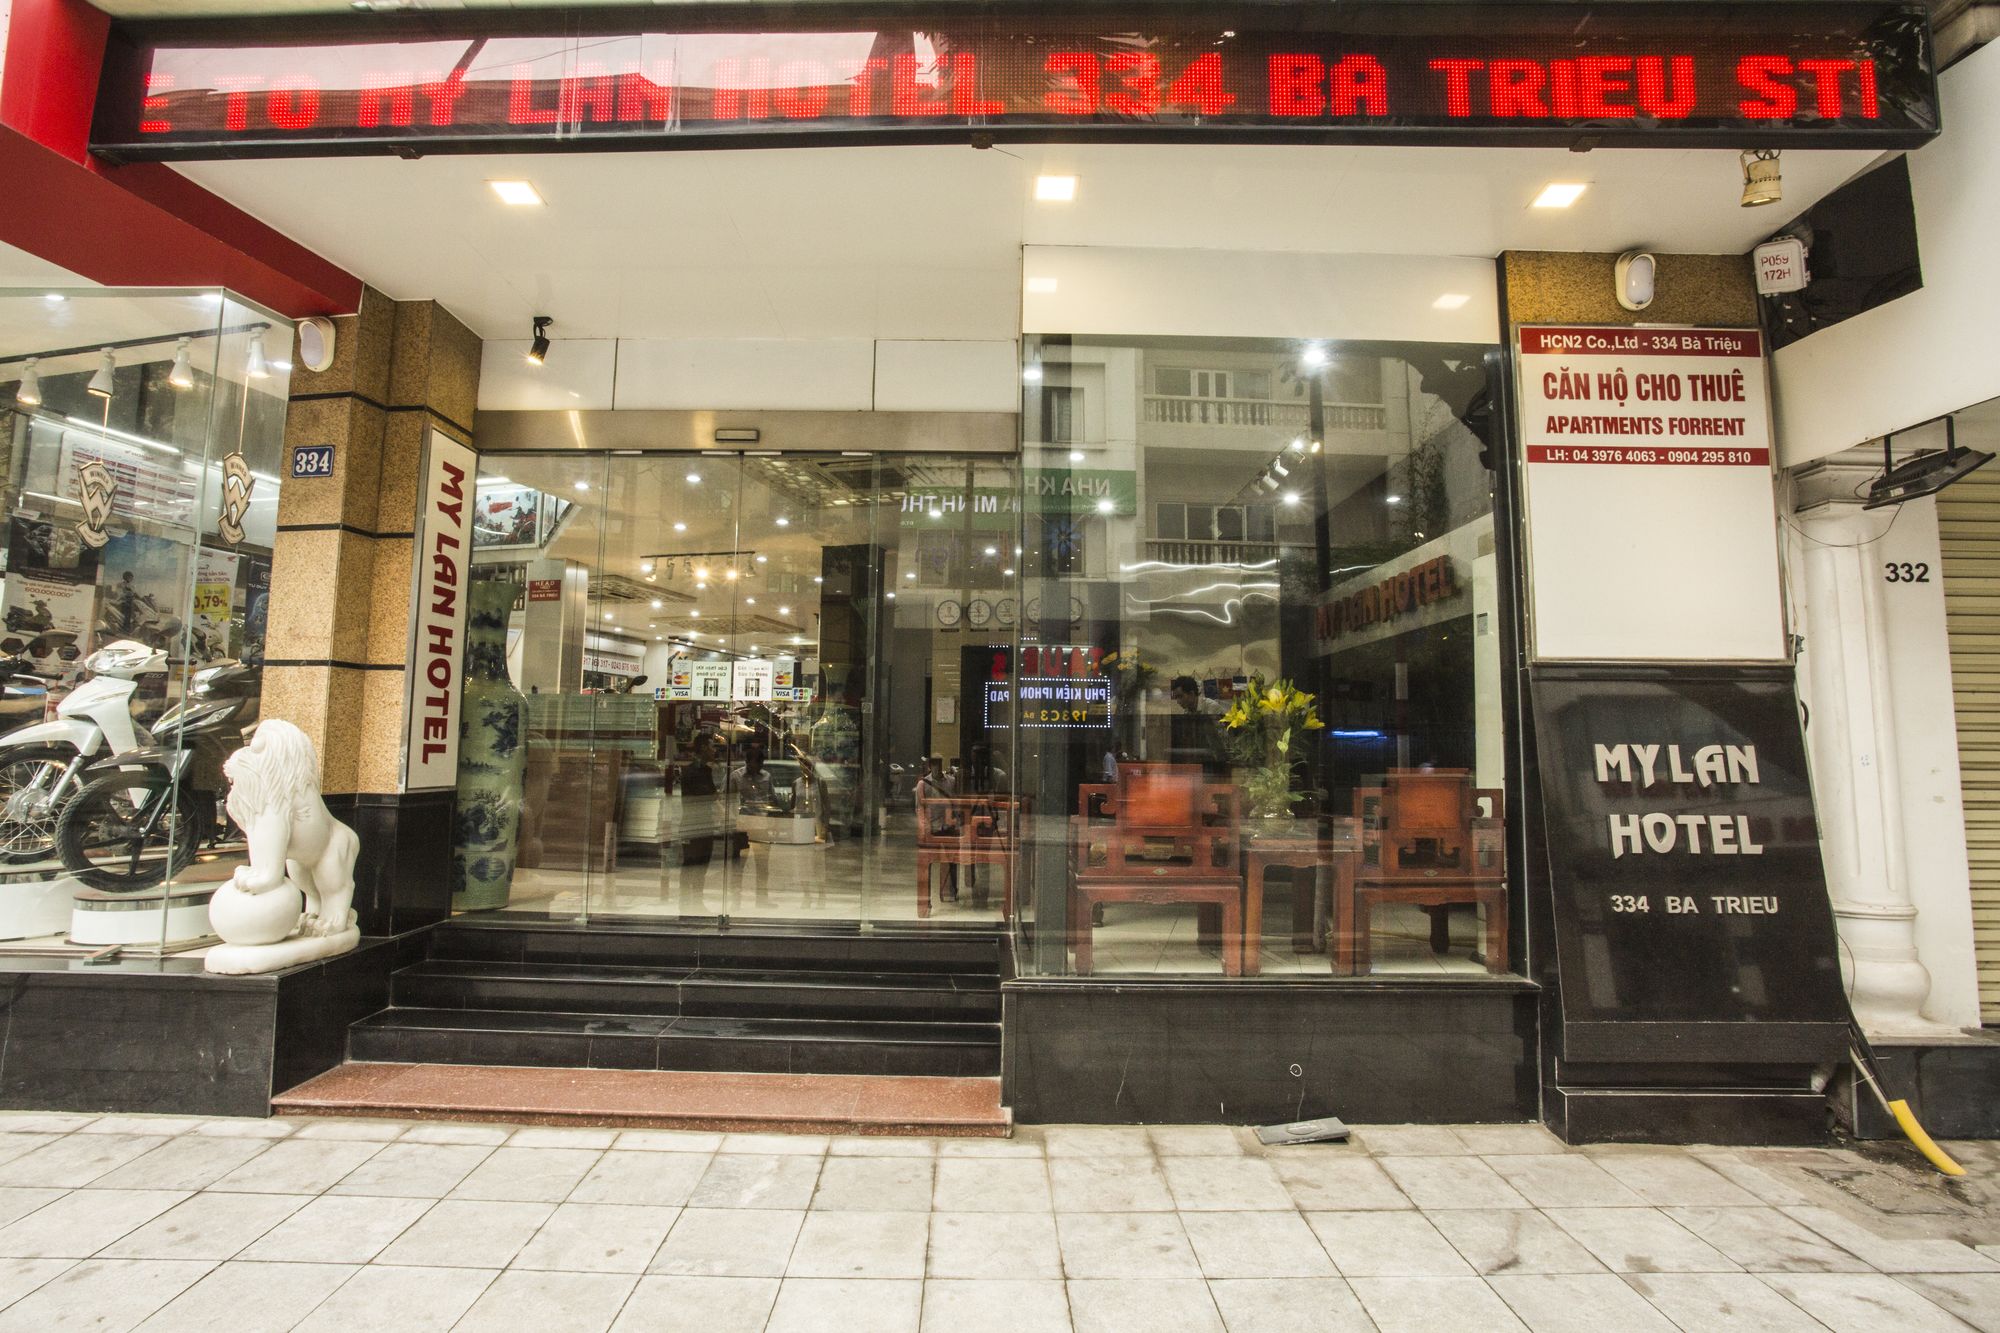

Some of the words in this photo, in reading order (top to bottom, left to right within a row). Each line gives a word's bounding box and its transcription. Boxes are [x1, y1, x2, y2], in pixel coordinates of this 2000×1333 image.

[214, 74, 321, 132] TO
[357, 66, 469, 129] MY
[507, 60, 673, 126] LAN
[714, 53, 1005, 118] HOTEL
[1043, 52, 1237, 117] 334
[1268, 53, 1388, 117] BA
[1428, 55, 1697, 119] TRIEU
[1764, 268, 1792, 281] 172H
[1540, 334, 1583, 349] HCN2
[1586, 335, 1639, 351] Co.,Ltd
[1652, 336, 1678, 350] 334
[1682, 336, 1702, 351] Bà
[1705, 336, 1742, 355] Triệu
[1543, 366, 1590, 401] CĂN
[1597, 366, 1629, 408] HỘ
[1635, 373, 1682, 402] CHO
[1688, 368, 1746, 403] THUÊ
[1546, 415, 1664, 436] APARTMENTS
[1669, 416, 1746, 437] FORRENT
[295, 450, 330, 473] 334
[1546, 449, 1570, 461] LH:
[1572, 450, 1589, 462] 04
[1592, 450, 1623, 462] 3976
[1625, 450, 1657, 463] 4063
[1668, 451, 1699, 463] 0904
[1702, 451, 1726, 463] 295
[1728, 451, 1751, 463] 810
[436, 460, 466, 529] MY
[431, 532, 460, 618] LAN
[1379, 554, 1453, 624] HOTEL
[1884, 562, 1930, 583] 332
[421, 624, 454, 765] HOTEL
[1594, 743, 1661, 788] MY
[1667, 744, 1760, 788] LAN
[1608, 812, 1764, 859] HOTEL
[1610, 894, 1650, 913] 334
[1665, 896, 1700, 914] BA
[1711, 896, 1779, 914] TRIEU
